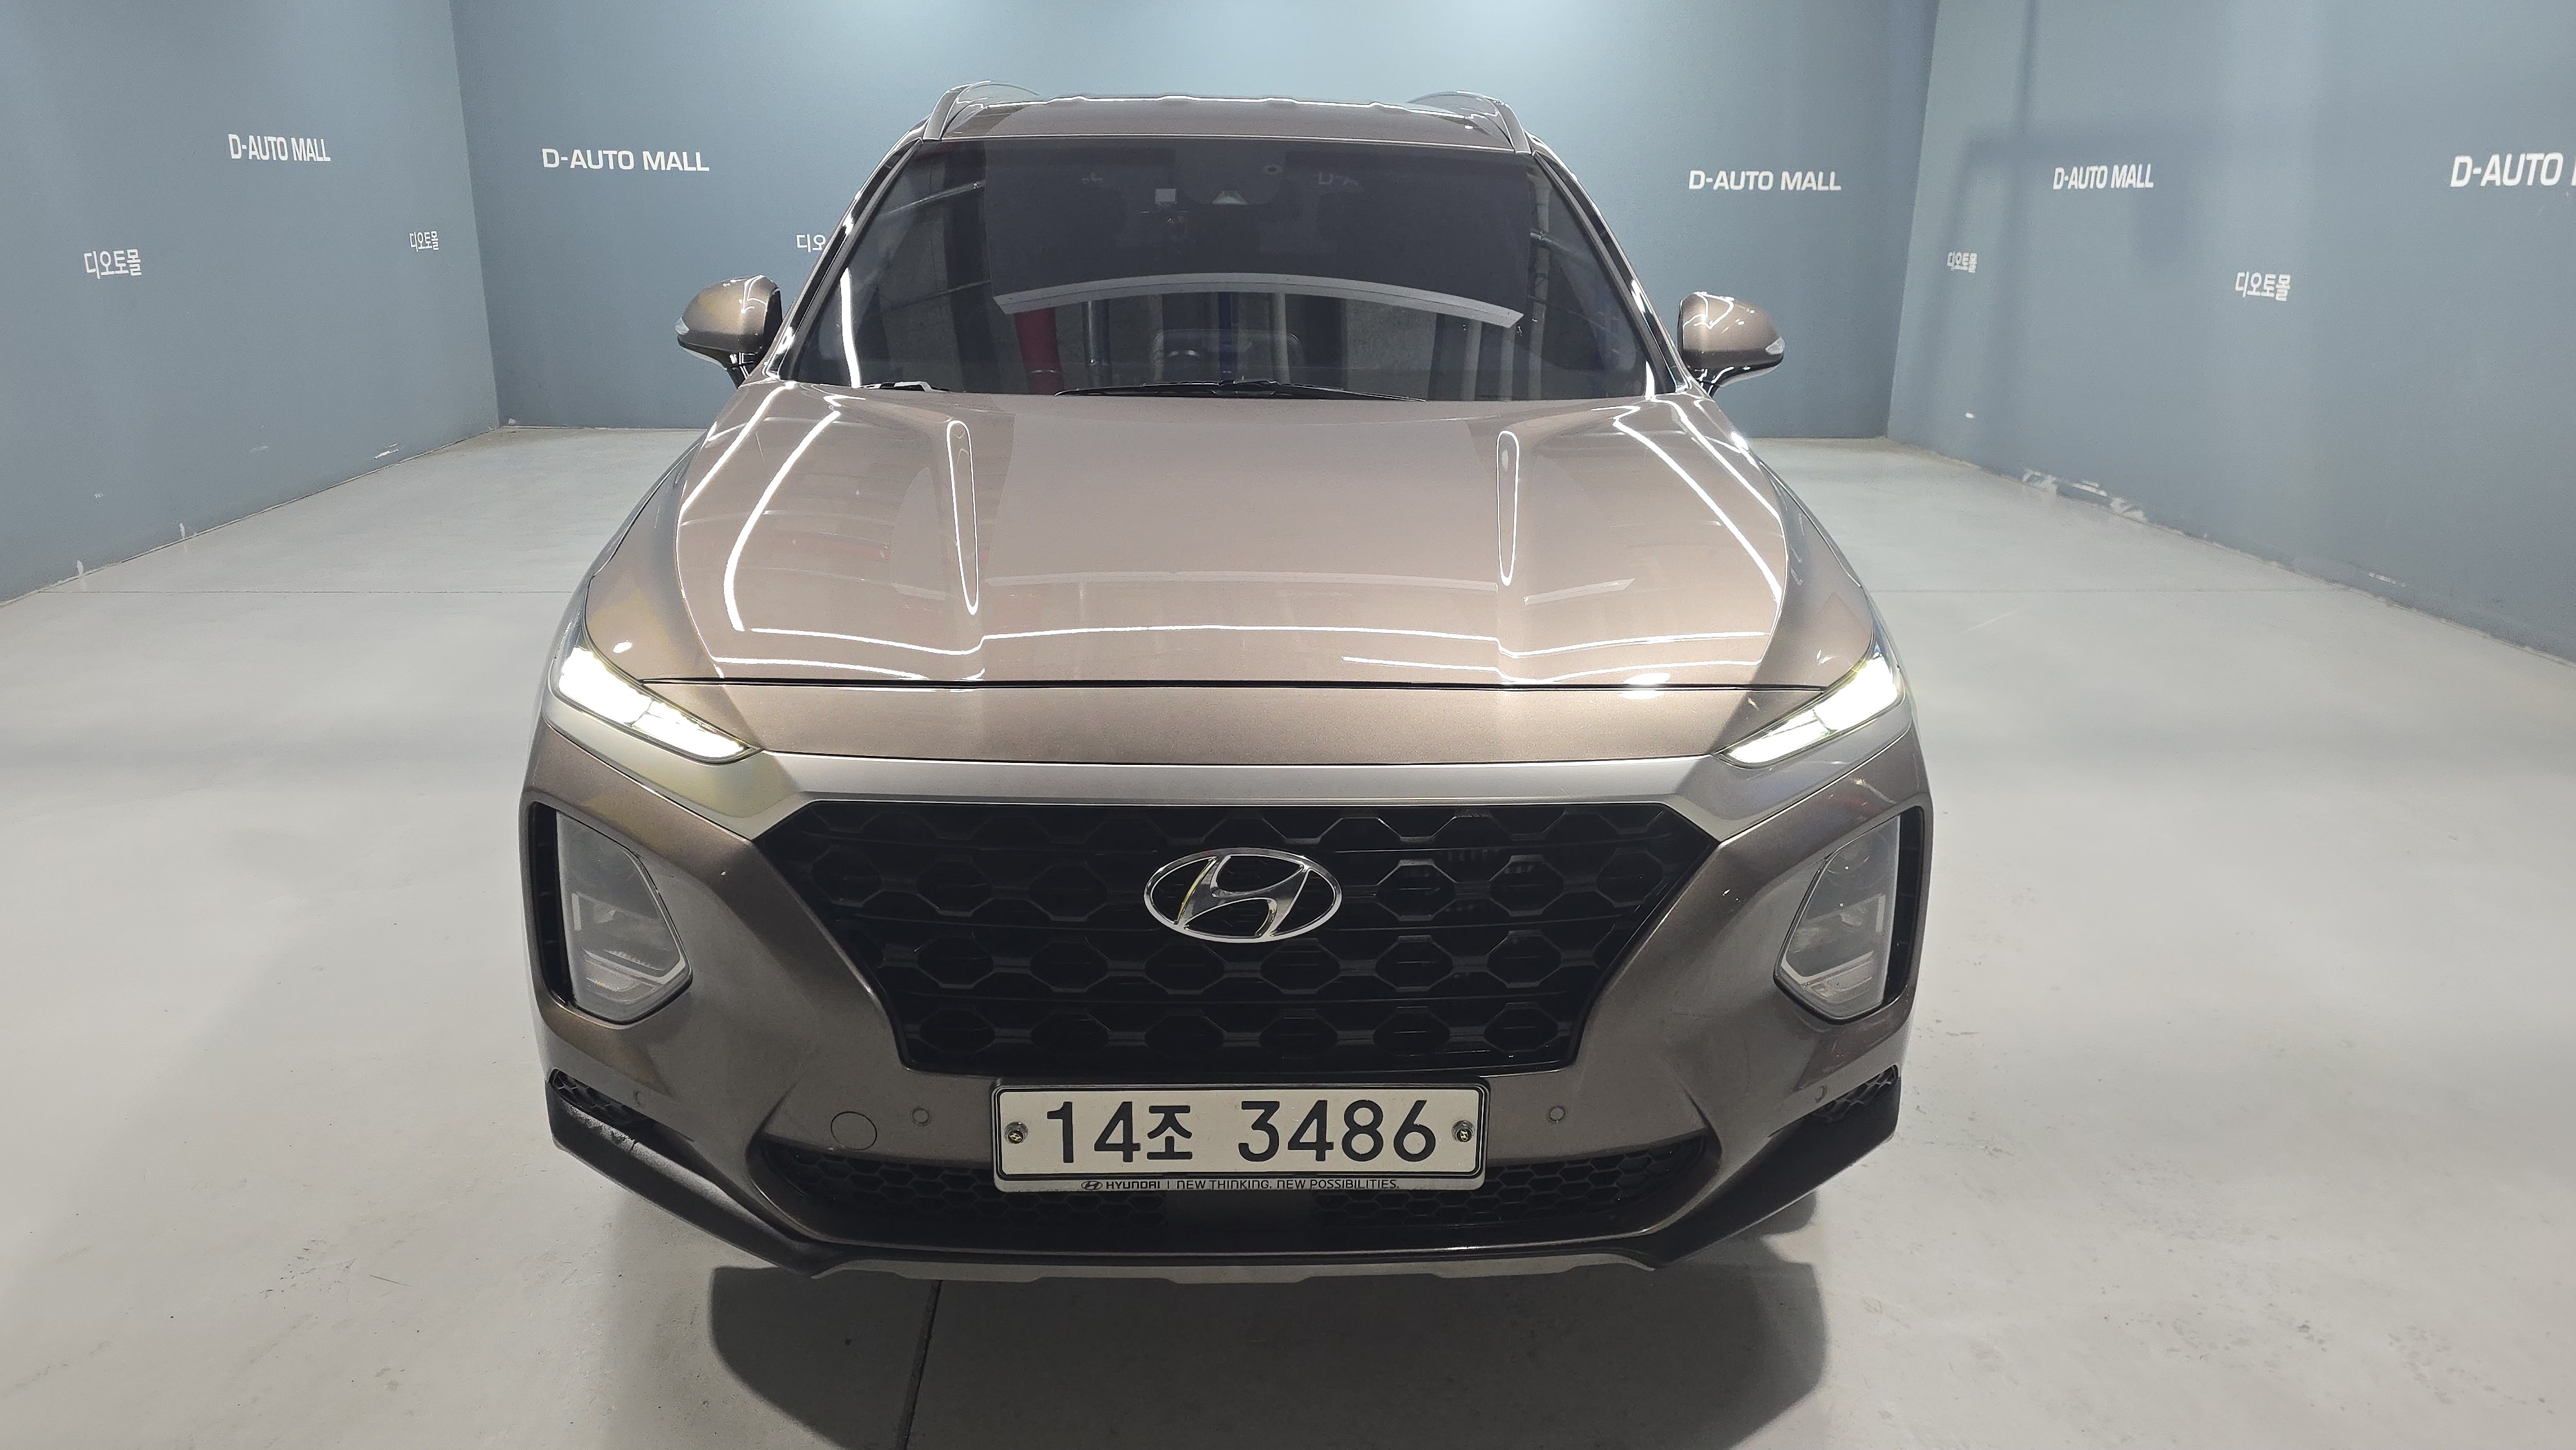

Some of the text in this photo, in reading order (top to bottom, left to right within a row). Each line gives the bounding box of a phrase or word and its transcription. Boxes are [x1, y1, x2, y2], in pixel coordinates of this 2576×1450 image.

[228, 133, 331, 162] D-AUTO MALL
[542, 148, 710, 171] D-AUTO MALL
[1689, 170, 1842, 191] D-AUTO MALL
[2052, 164, 2154, 190] D-AUTO MALL
[2450, 152, 2564, 187] D-AUTO
[409, 231, 439, 252] 디오토몰
[84, 249, 142, 279] 디오토몰
[2235, 271, 2291, 301] 디오토몰
[1046, 1099, 1437, 1163] 14조 3486
[1106, 1180, 1400, 1190] HYUNDAI NEW THINKING. NEW POSSIBILITIES.
